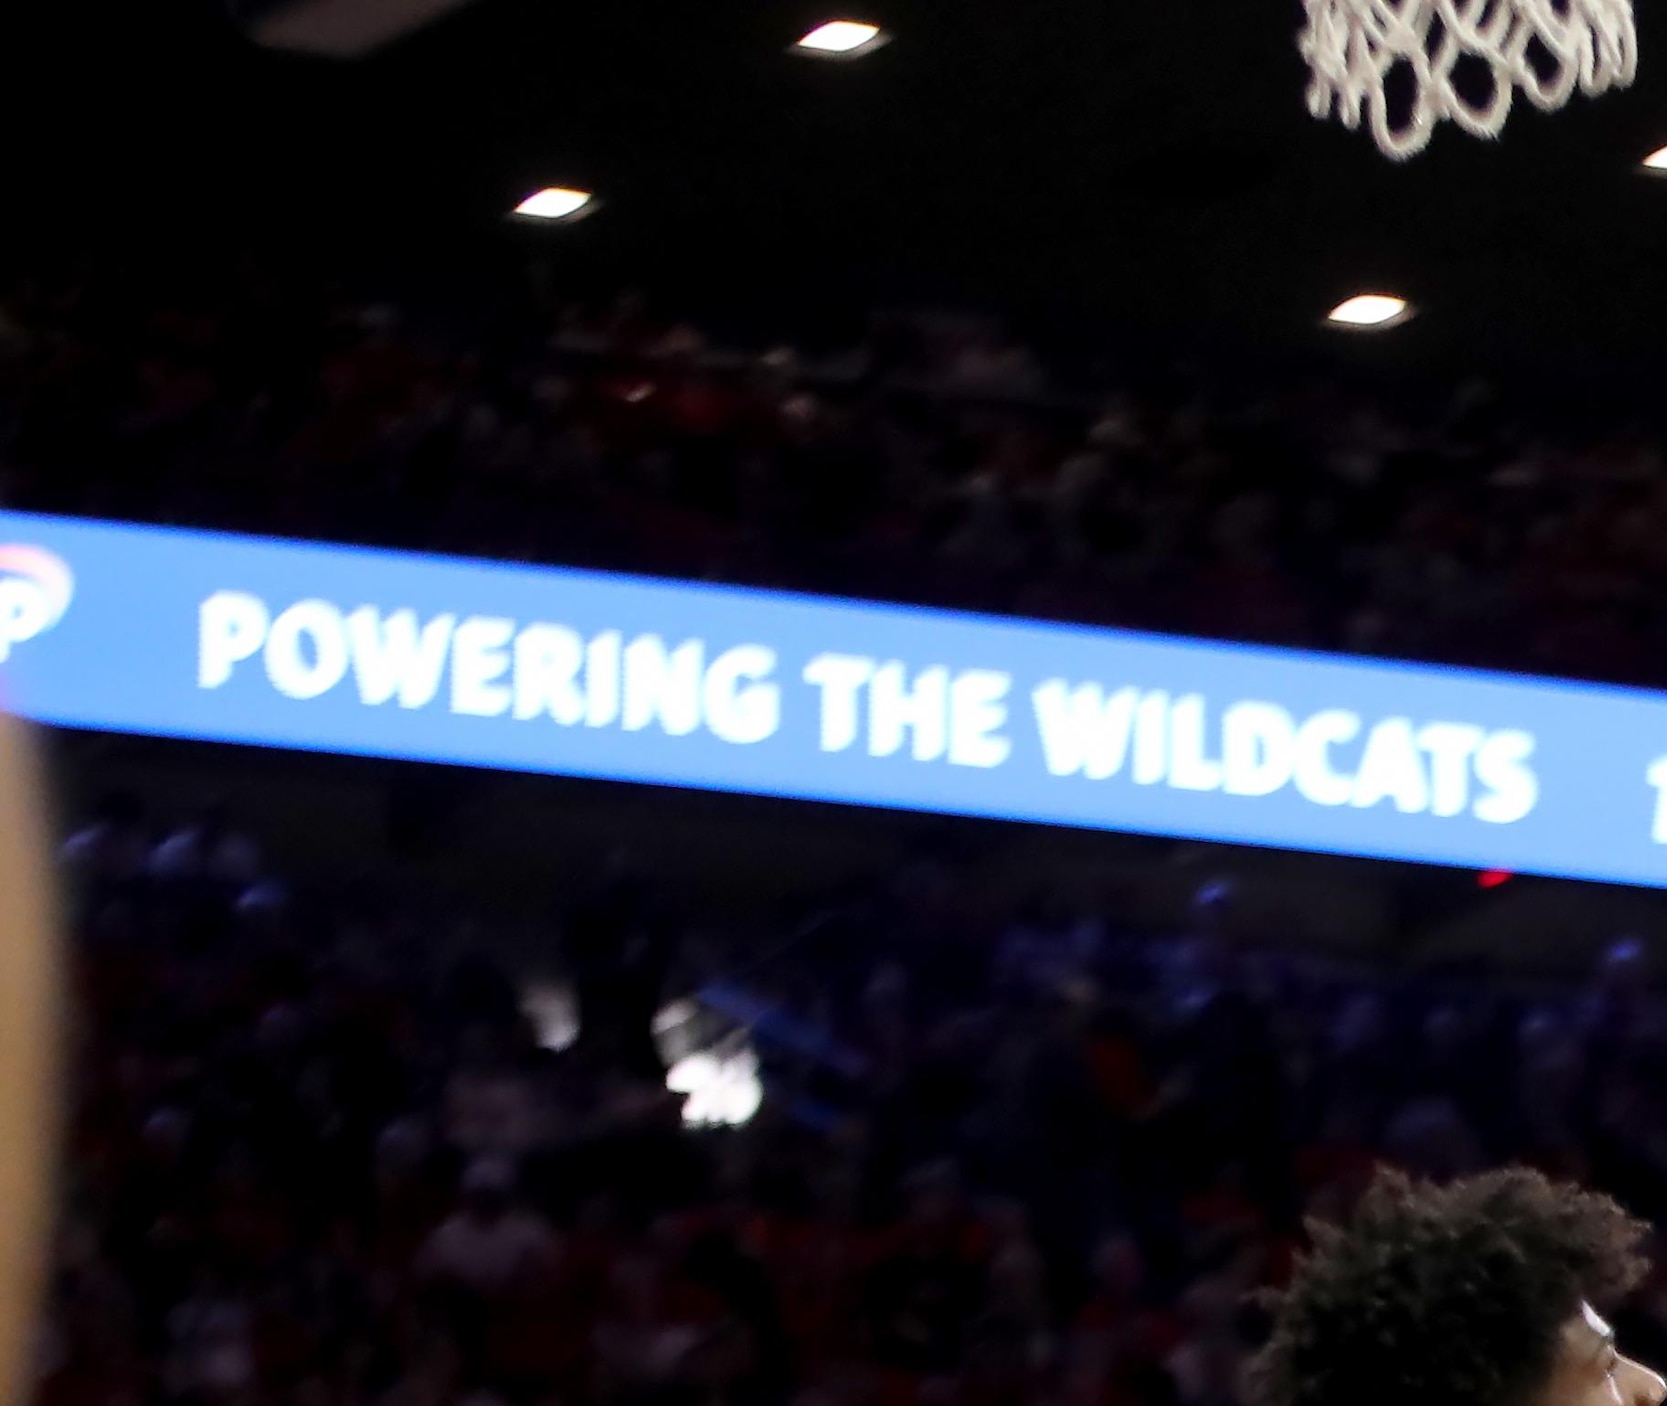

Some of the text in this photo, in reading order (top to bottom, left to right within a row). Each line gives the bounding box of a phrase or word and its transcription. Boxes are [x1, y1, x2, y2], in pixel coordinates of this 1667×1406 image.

[198, 590, 780, 744] POWERING
[805, 655, 1010, 768] THE
[1031, 677, 1538, 824] WILDCATS
